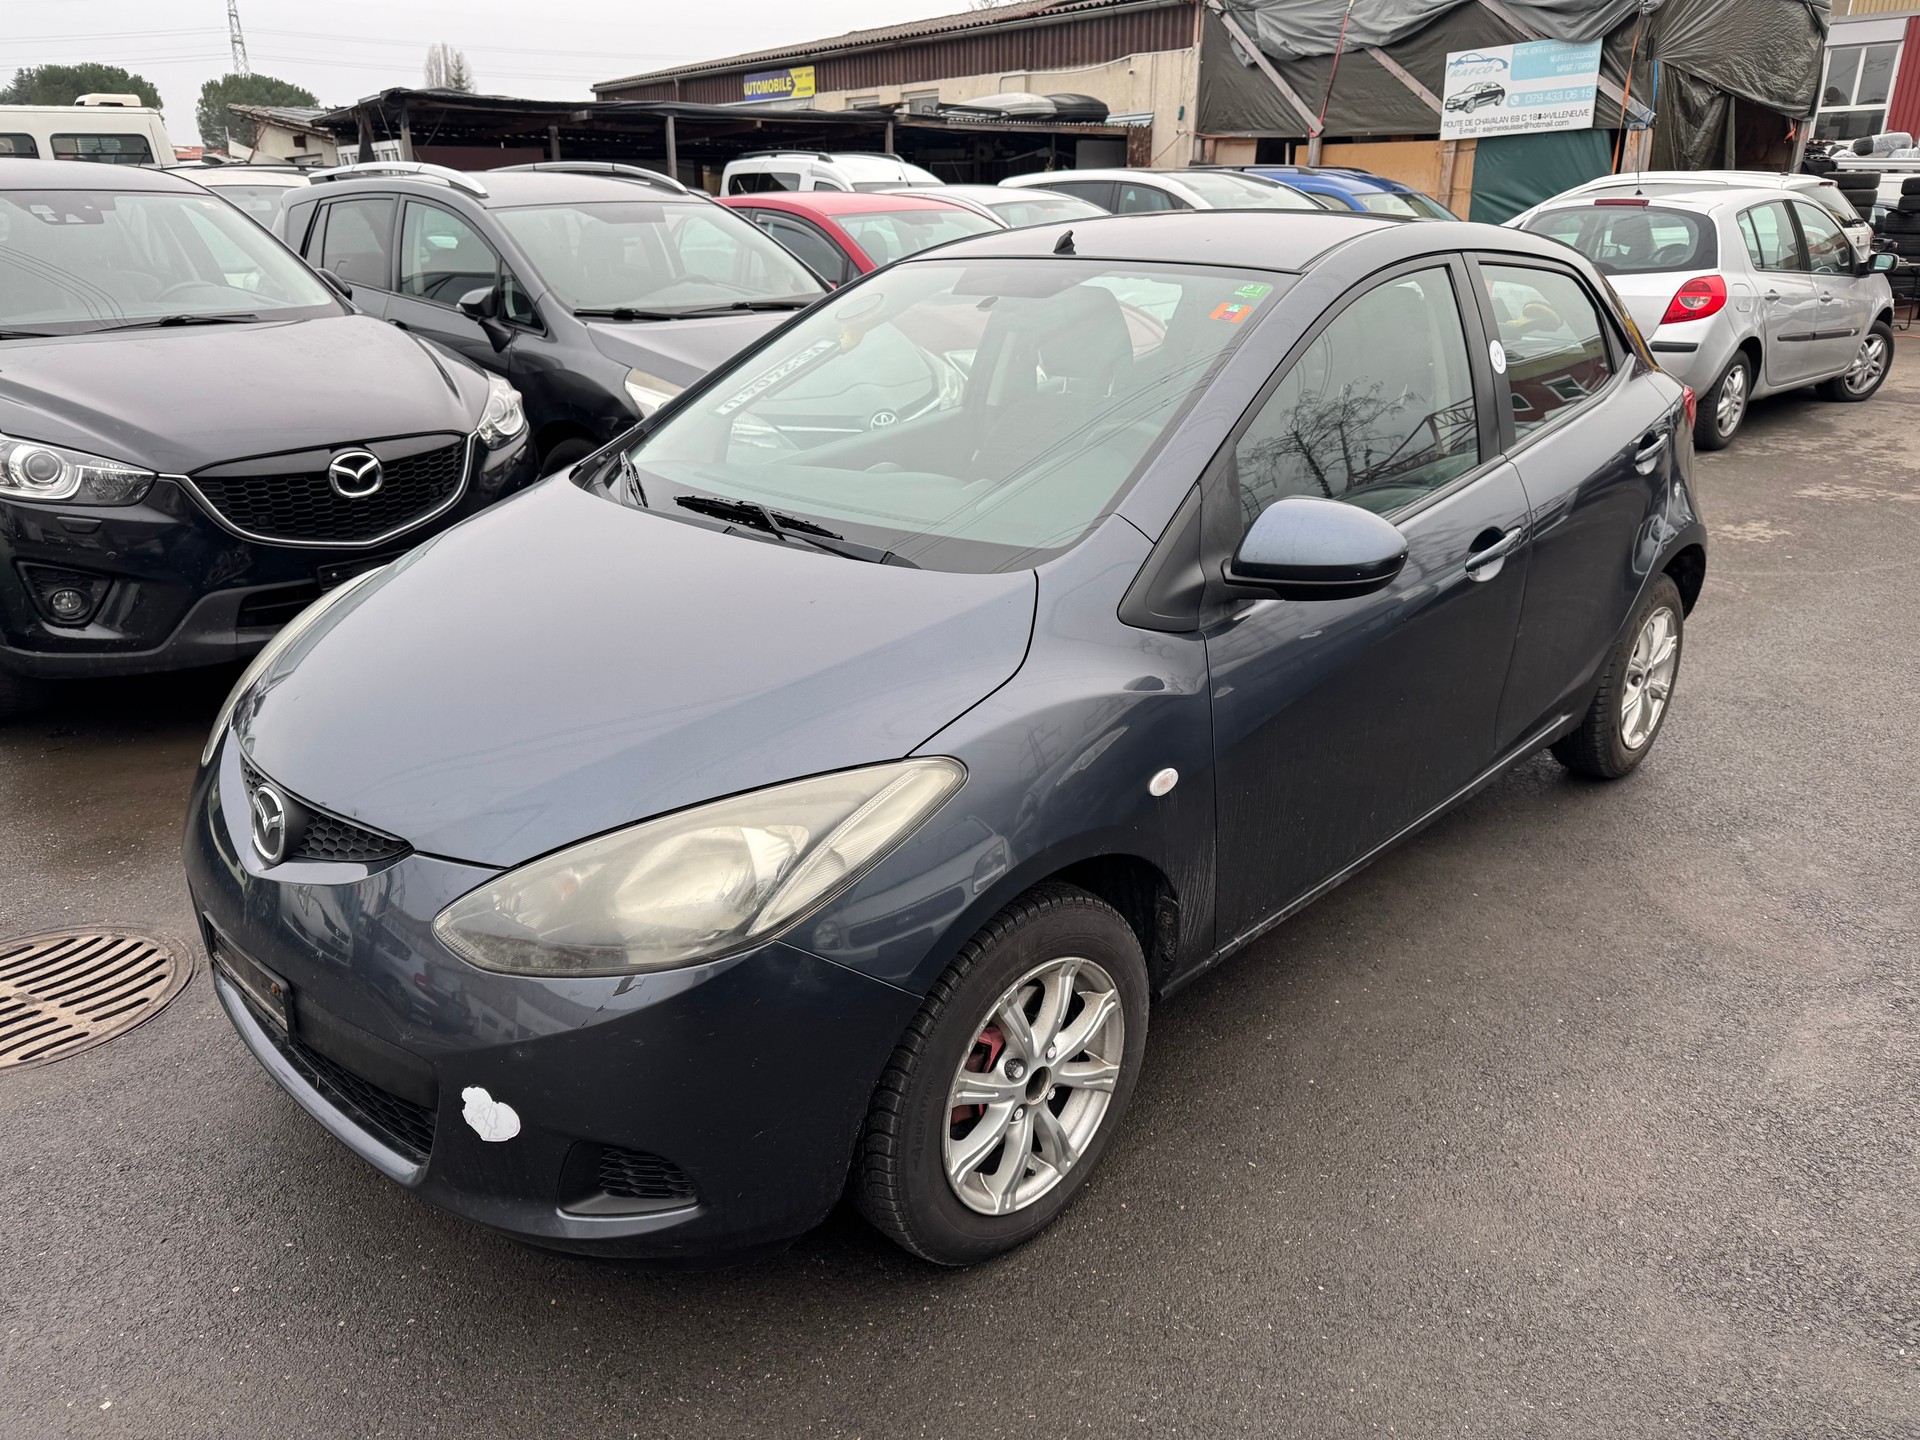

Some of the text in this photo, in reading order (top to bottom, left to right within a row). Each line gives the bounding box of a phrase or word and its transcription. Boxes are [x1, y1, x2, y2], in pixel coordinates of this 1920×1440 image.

[1525, 88, 1593, 103] 079 433 06 15
[1443, 120, 1463, 128] ROUTE
